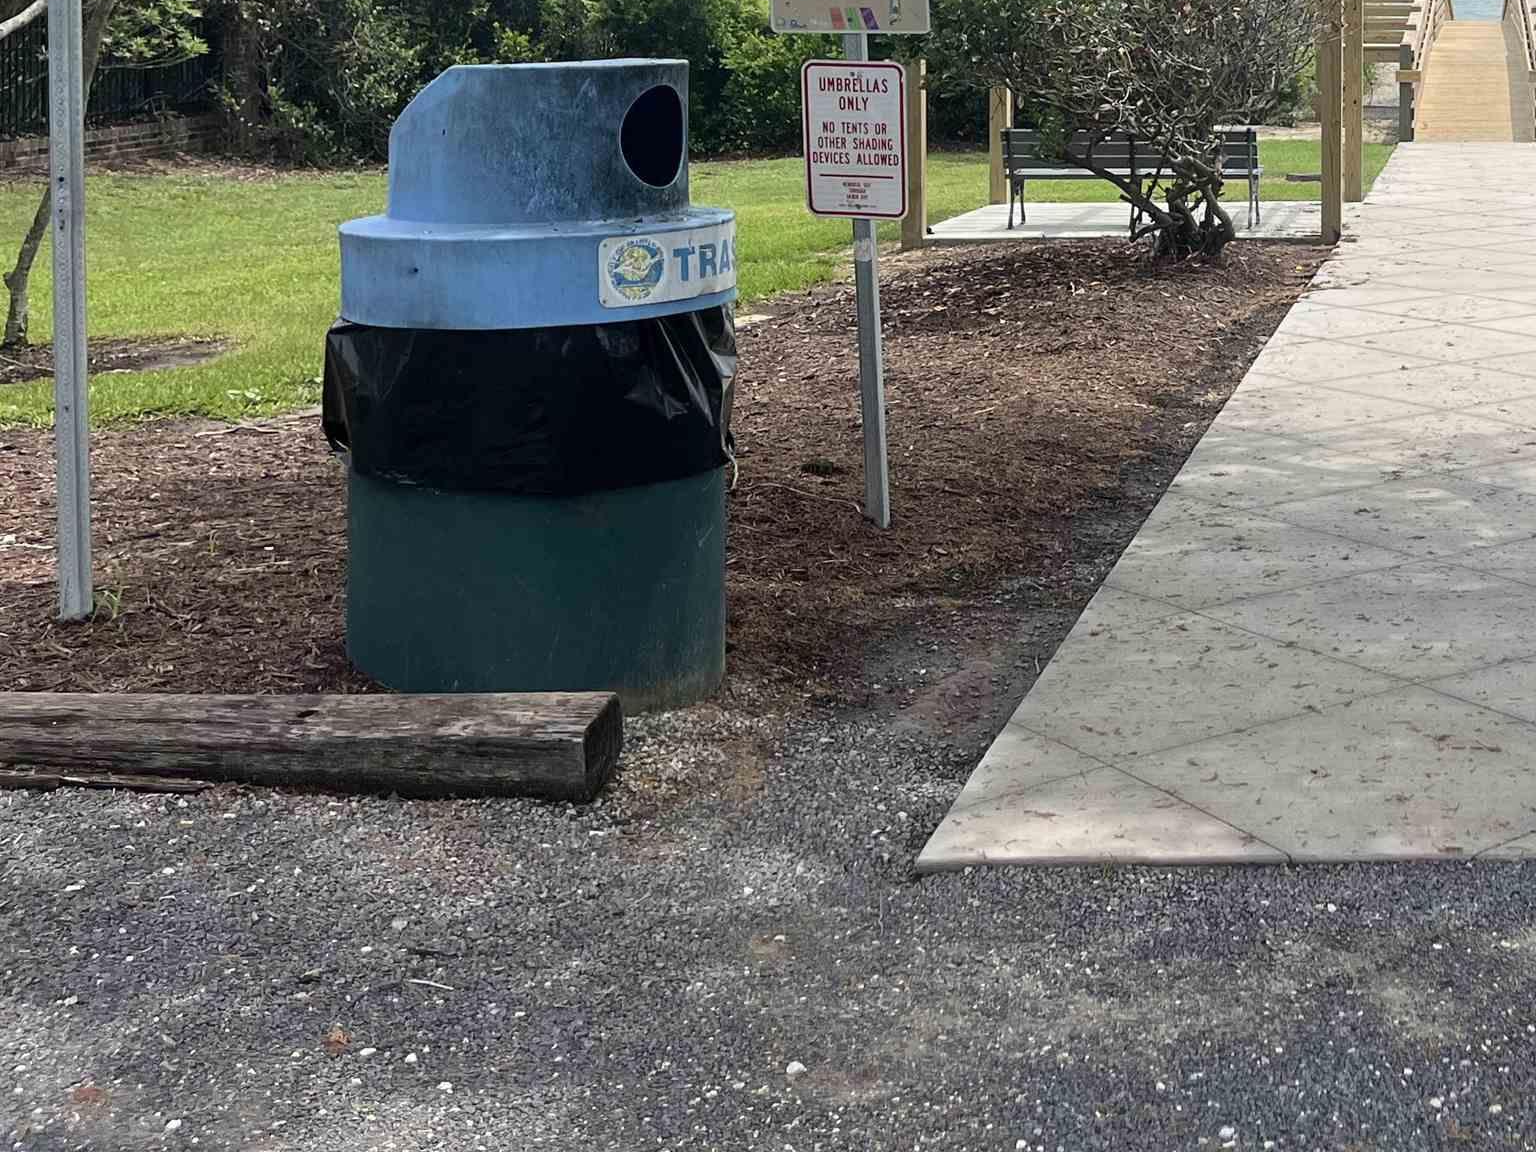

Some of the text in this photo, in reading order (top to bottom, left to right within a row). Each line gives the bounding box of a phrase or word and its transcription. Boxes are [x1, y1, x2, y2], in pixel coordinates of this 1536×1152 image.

[819, 77, 888, 94] UMBRELLAS
[839, 96, 869, 111] ONLY
[822, 121, 887, 135] NO TENTS OR
[818, 137, 893, 151] OTHER SHADING
[812, 152, 899, 167] DEVICES ALLOWED
